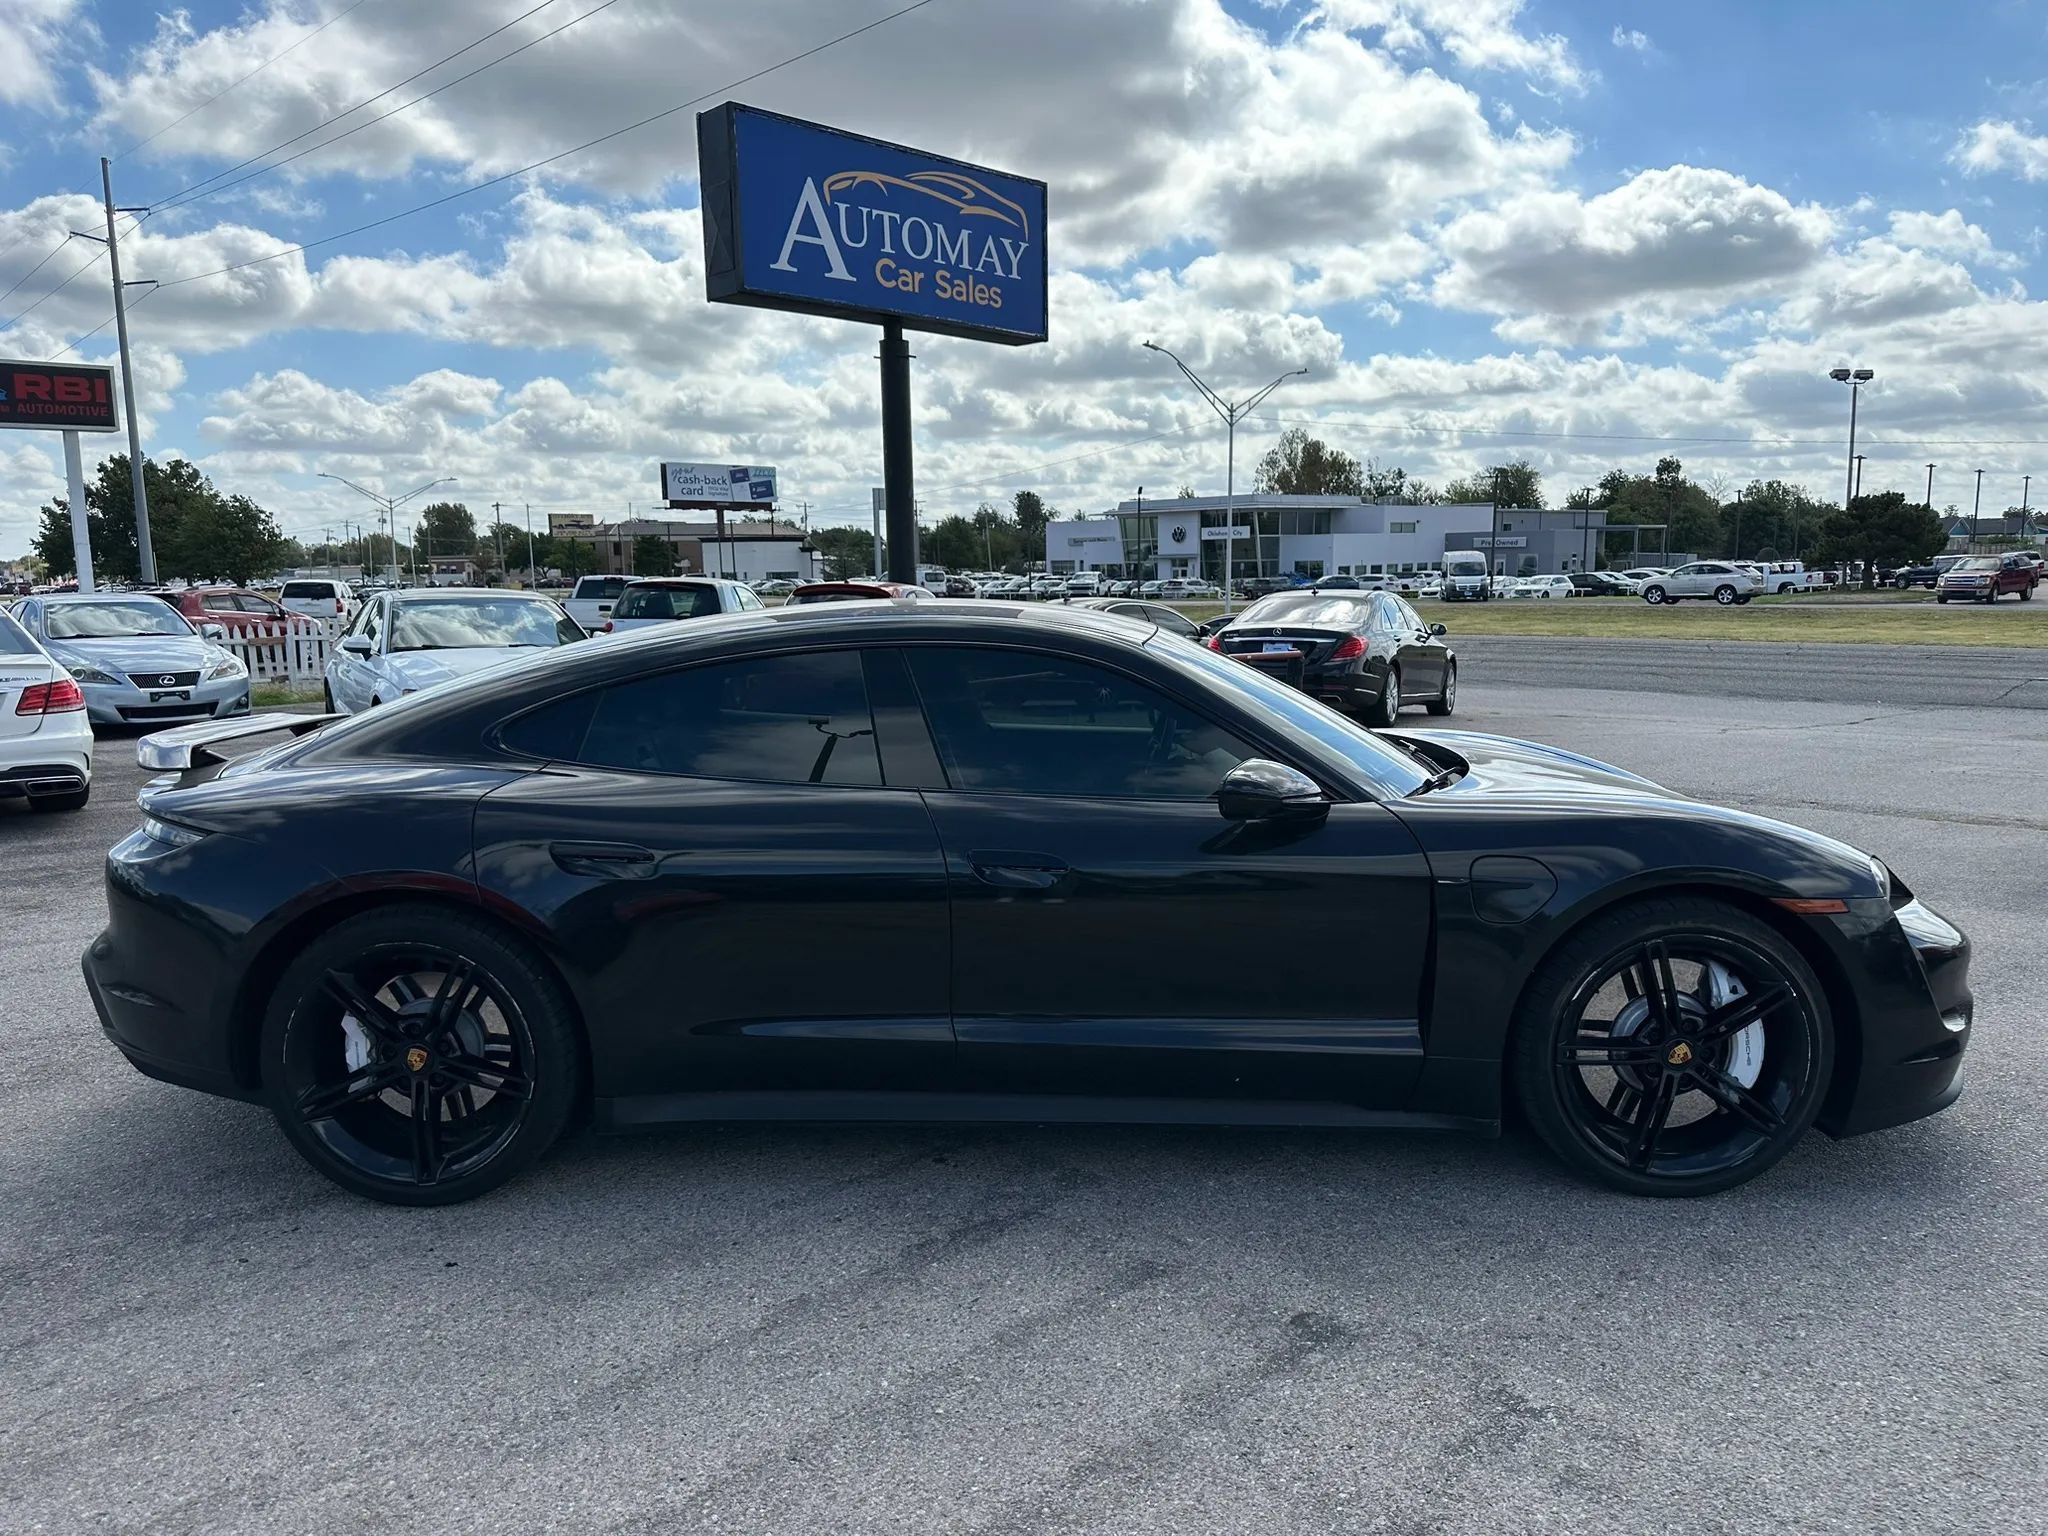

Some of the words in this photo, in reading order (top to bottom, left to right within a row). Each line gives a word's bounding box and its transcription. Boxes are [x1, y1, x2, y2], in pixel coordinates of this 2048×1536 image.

[770, 177, 1029, 281] AUTOMAY
[875, 257, 925, 293] Car
[935, 269, 1002, 309] Sales
[14, 373, 107, 403] RBI
[17, 403, 109, 417] AUTOMOTIVE
[678, 474, 728, 486] cash-back
[681, 485, 704, 496] card
